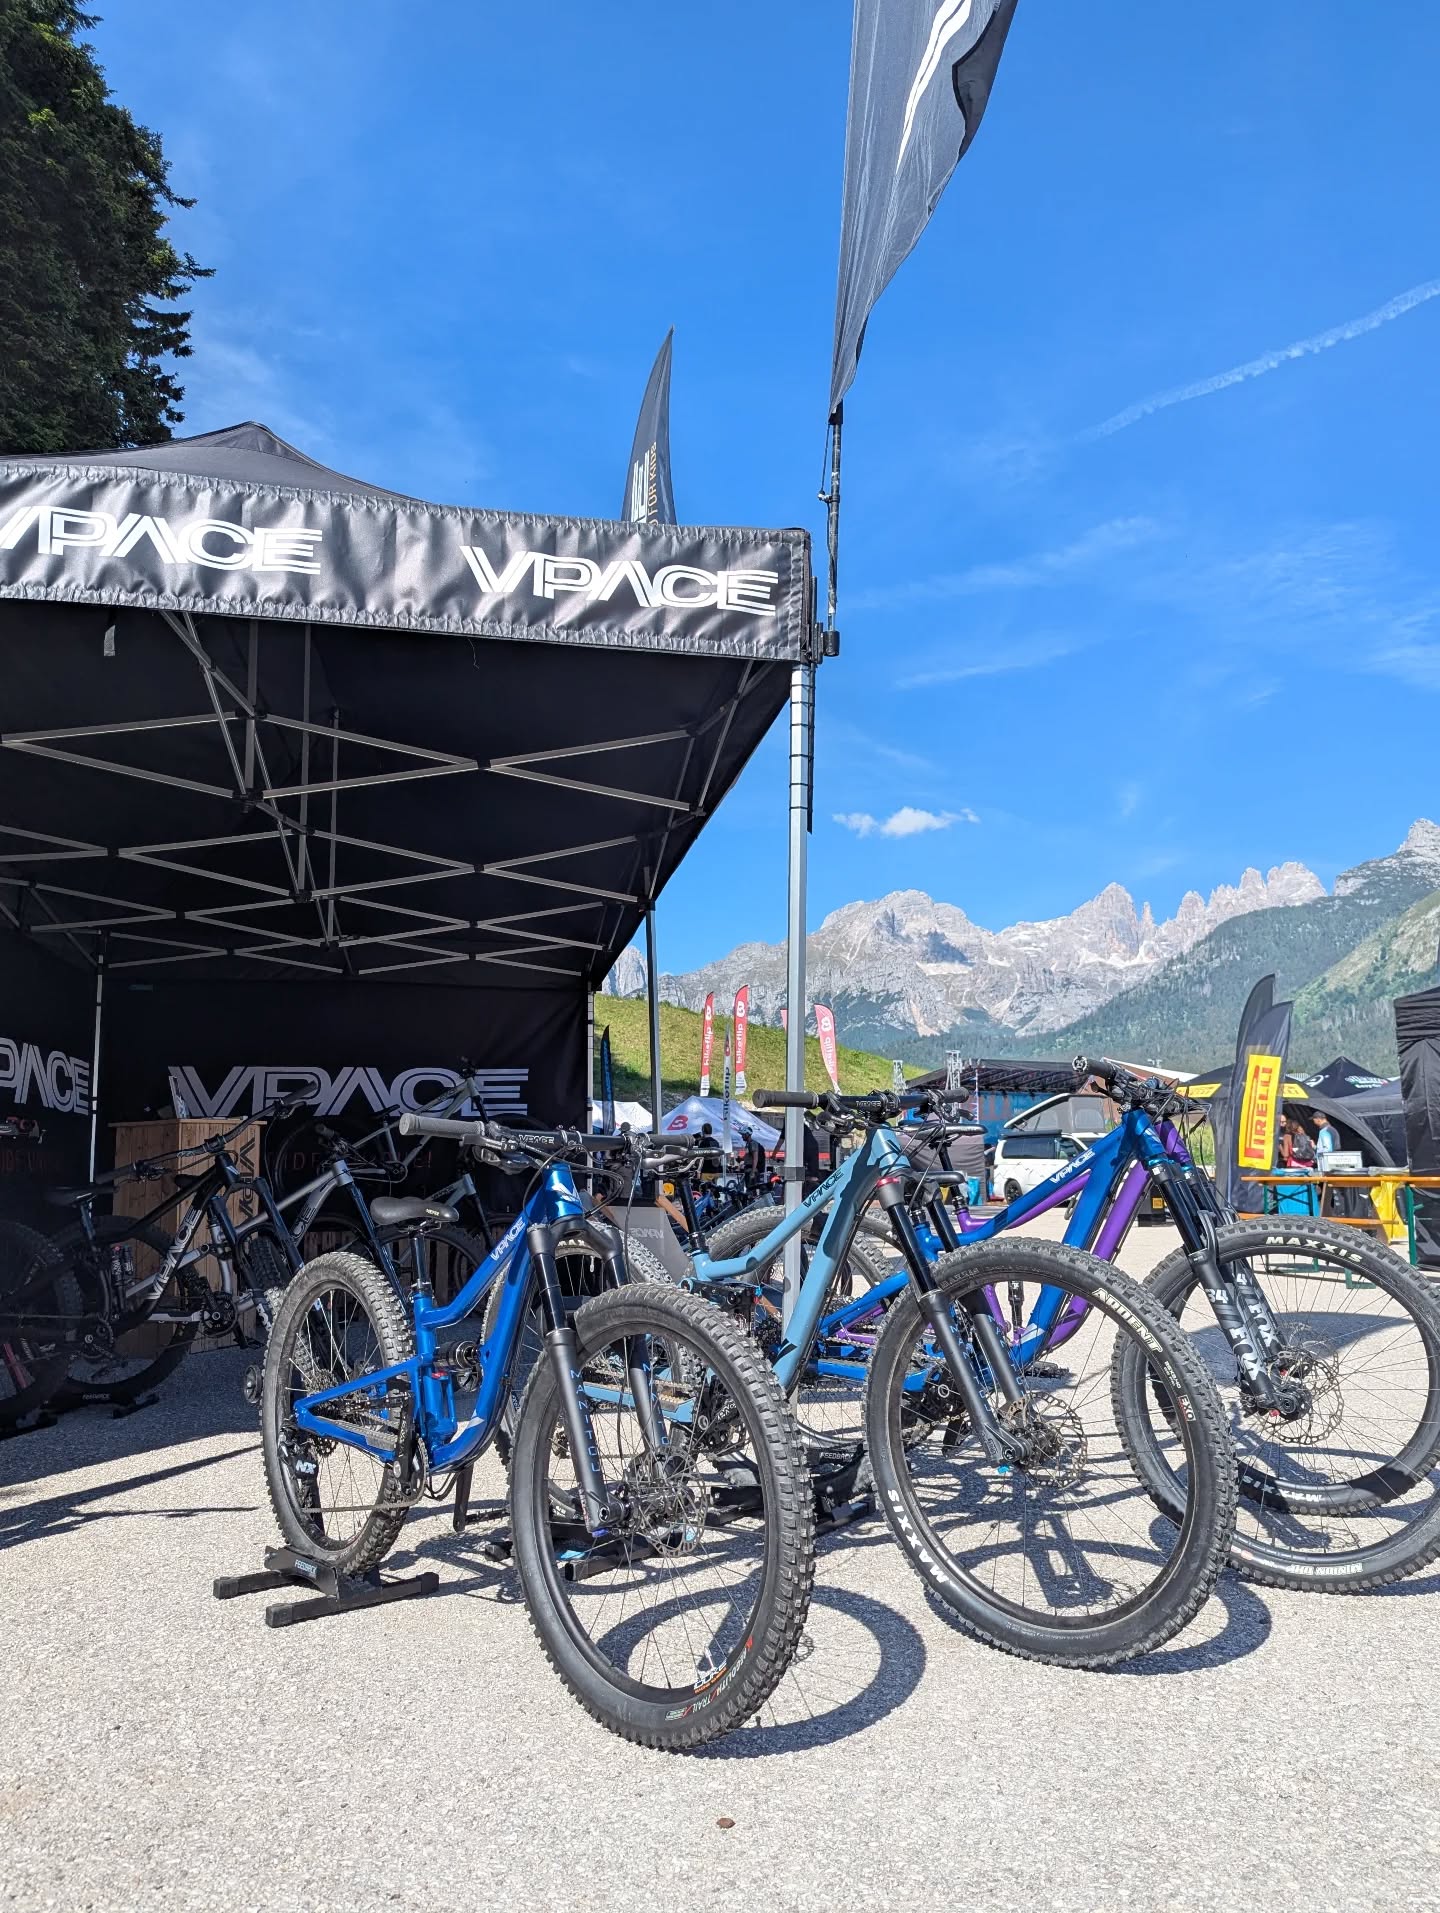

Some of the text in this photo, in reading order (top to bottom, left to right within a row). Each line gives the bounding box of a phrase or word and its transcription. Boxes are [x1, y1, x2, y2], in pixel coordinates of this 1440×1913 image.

[460, 546, 779, 616] VPACE
[167, 1066, 529, 1117] VPACE
[1243, 1065, 1273, 1160] PIRELLI
[518, 1133, 555, 1144] VPACE
[1049, 1148, 1096, 1183] VPACE
[803, 1168, 845, 1208] VPACE
[491, 1217, 526, 1261] VPACE
[1265, 1236, 1363, 1262] MAXXIS
[1205, 1288, 1229, 1304] 34
[1092, 1287, 1163, 1352] ARDENT
[570, 1369, 601, 1472] MANITOU
[1180, 1396, 1196, 1421] EXO
[296, 1460, 317, 1475] NX
[887, 1489, 949, 1583] MAXXIS
[294, 1559, 317, 1575] FEEDBACK
